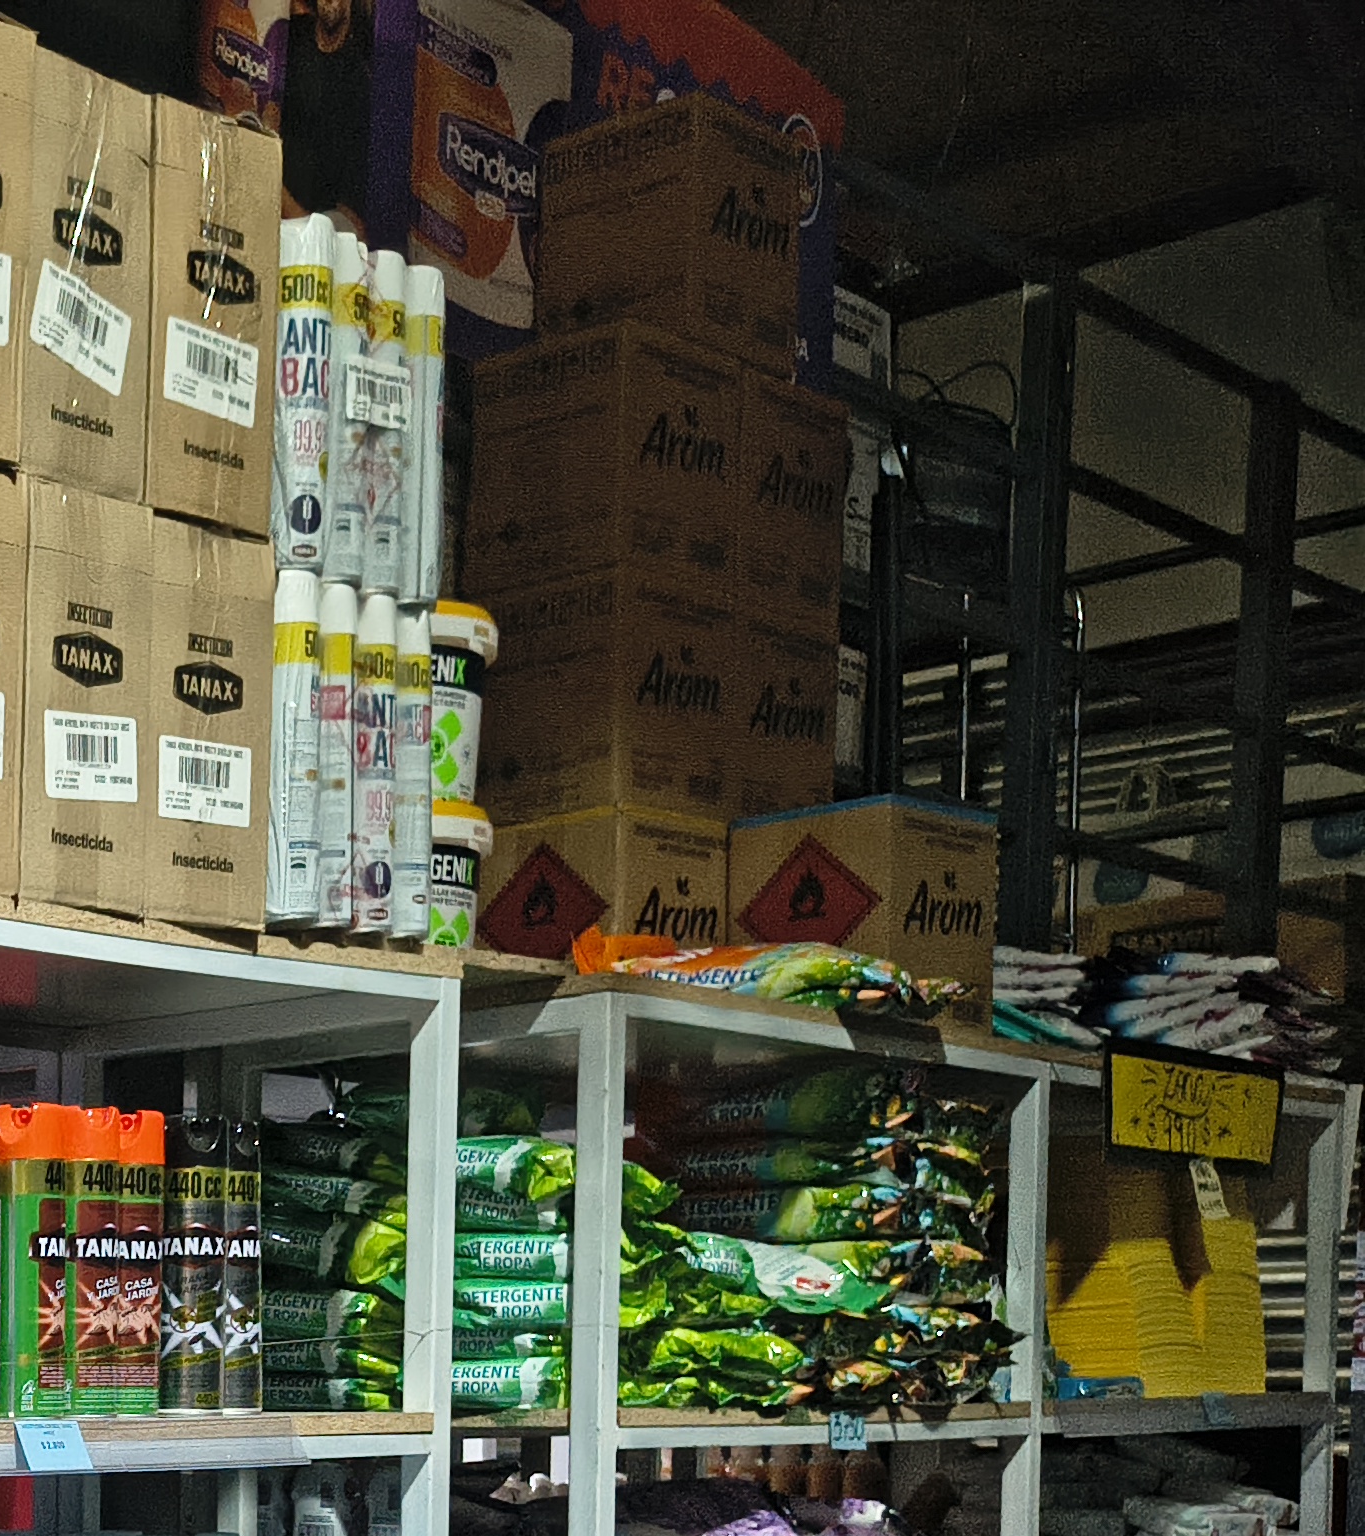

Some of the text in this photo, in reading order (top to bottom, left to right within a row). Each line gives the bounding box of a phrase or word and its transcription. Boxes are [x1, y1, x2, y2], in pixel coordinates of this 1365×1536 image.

[61, 642, 114, 677] TANAX
[182, 674, 234, 703] TANAX
[51, 827, 114, 853] Insecticida
[461, 1287, 563, 1304] DETERGENTE
[502, 1305, 542, 1318] ROPA
[461, 1381, 499, 1394] ROPA
